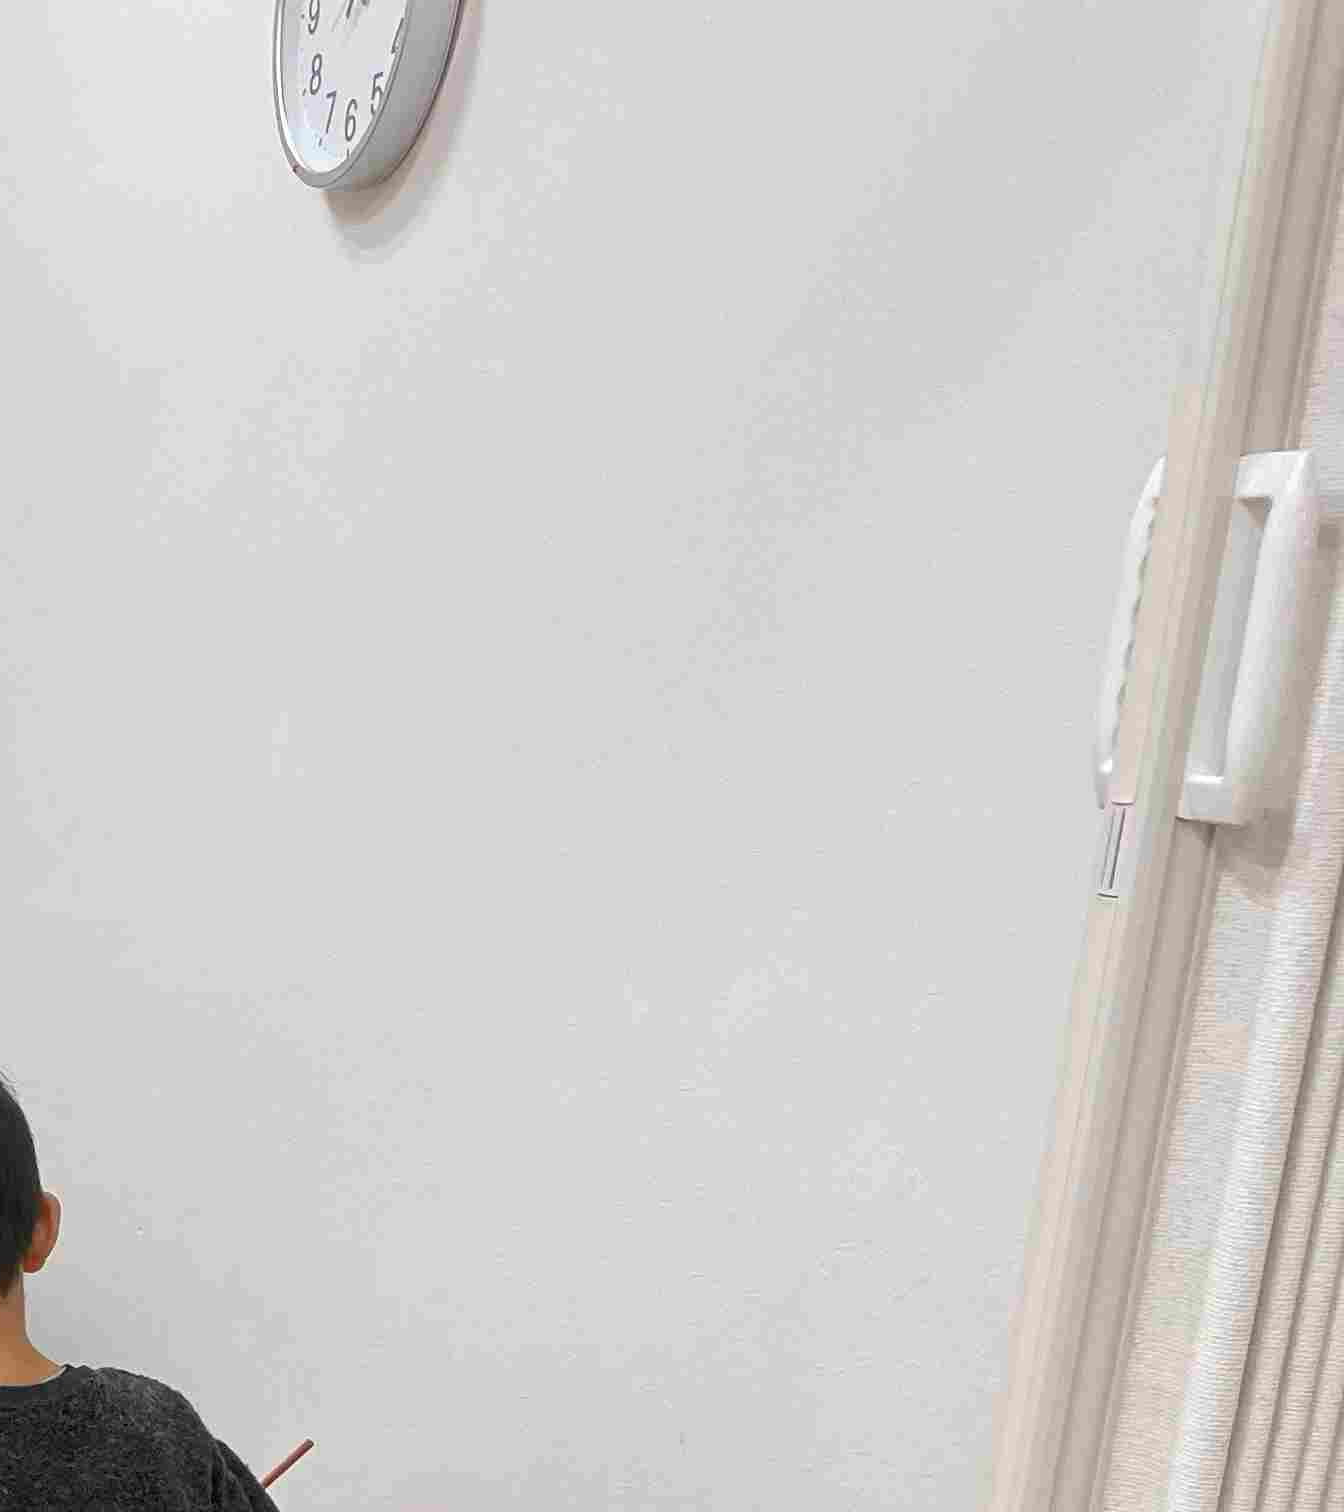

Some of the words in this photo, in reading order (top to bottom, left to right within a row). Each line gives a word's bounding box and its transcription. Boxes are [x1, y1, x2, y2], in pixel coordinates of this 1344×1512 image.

[310, 53, 322, 95] 8
[326, 91, 337, 133] 7
[345, 98, 358, 141] 6
